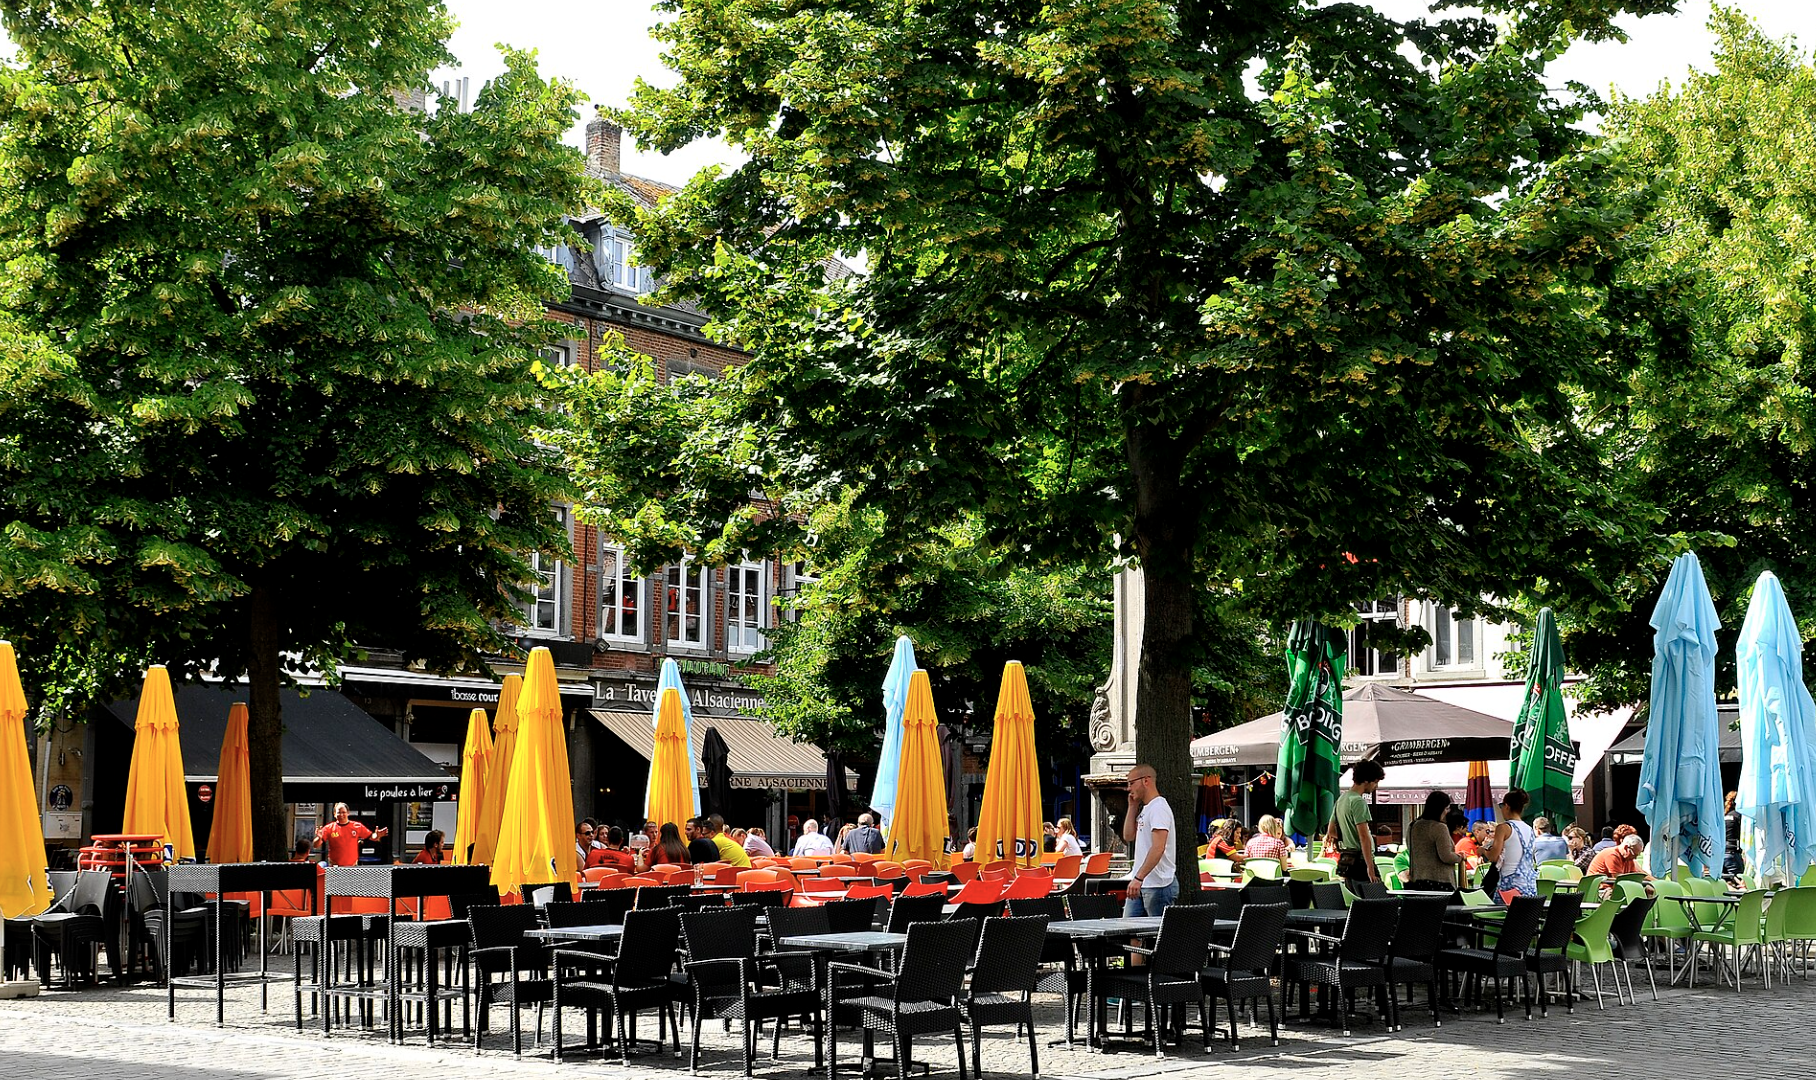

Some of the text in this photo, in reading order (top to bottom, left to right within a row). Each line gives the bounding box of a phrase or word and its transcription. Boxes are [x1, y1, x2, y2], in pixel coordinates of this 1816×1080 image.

[595, 681, 764, 709] La Tave Alsacienne
[1190, 745, 1236, 757] RIMBERGEN
[1394, 739, 1447, 751] GRIMBERGEN
[698, 776, 751, 787] TARNE
[365, 785, 378, 797] les
[380, 785, 407, 801] poules
[418, 785, 433, 797] lier
